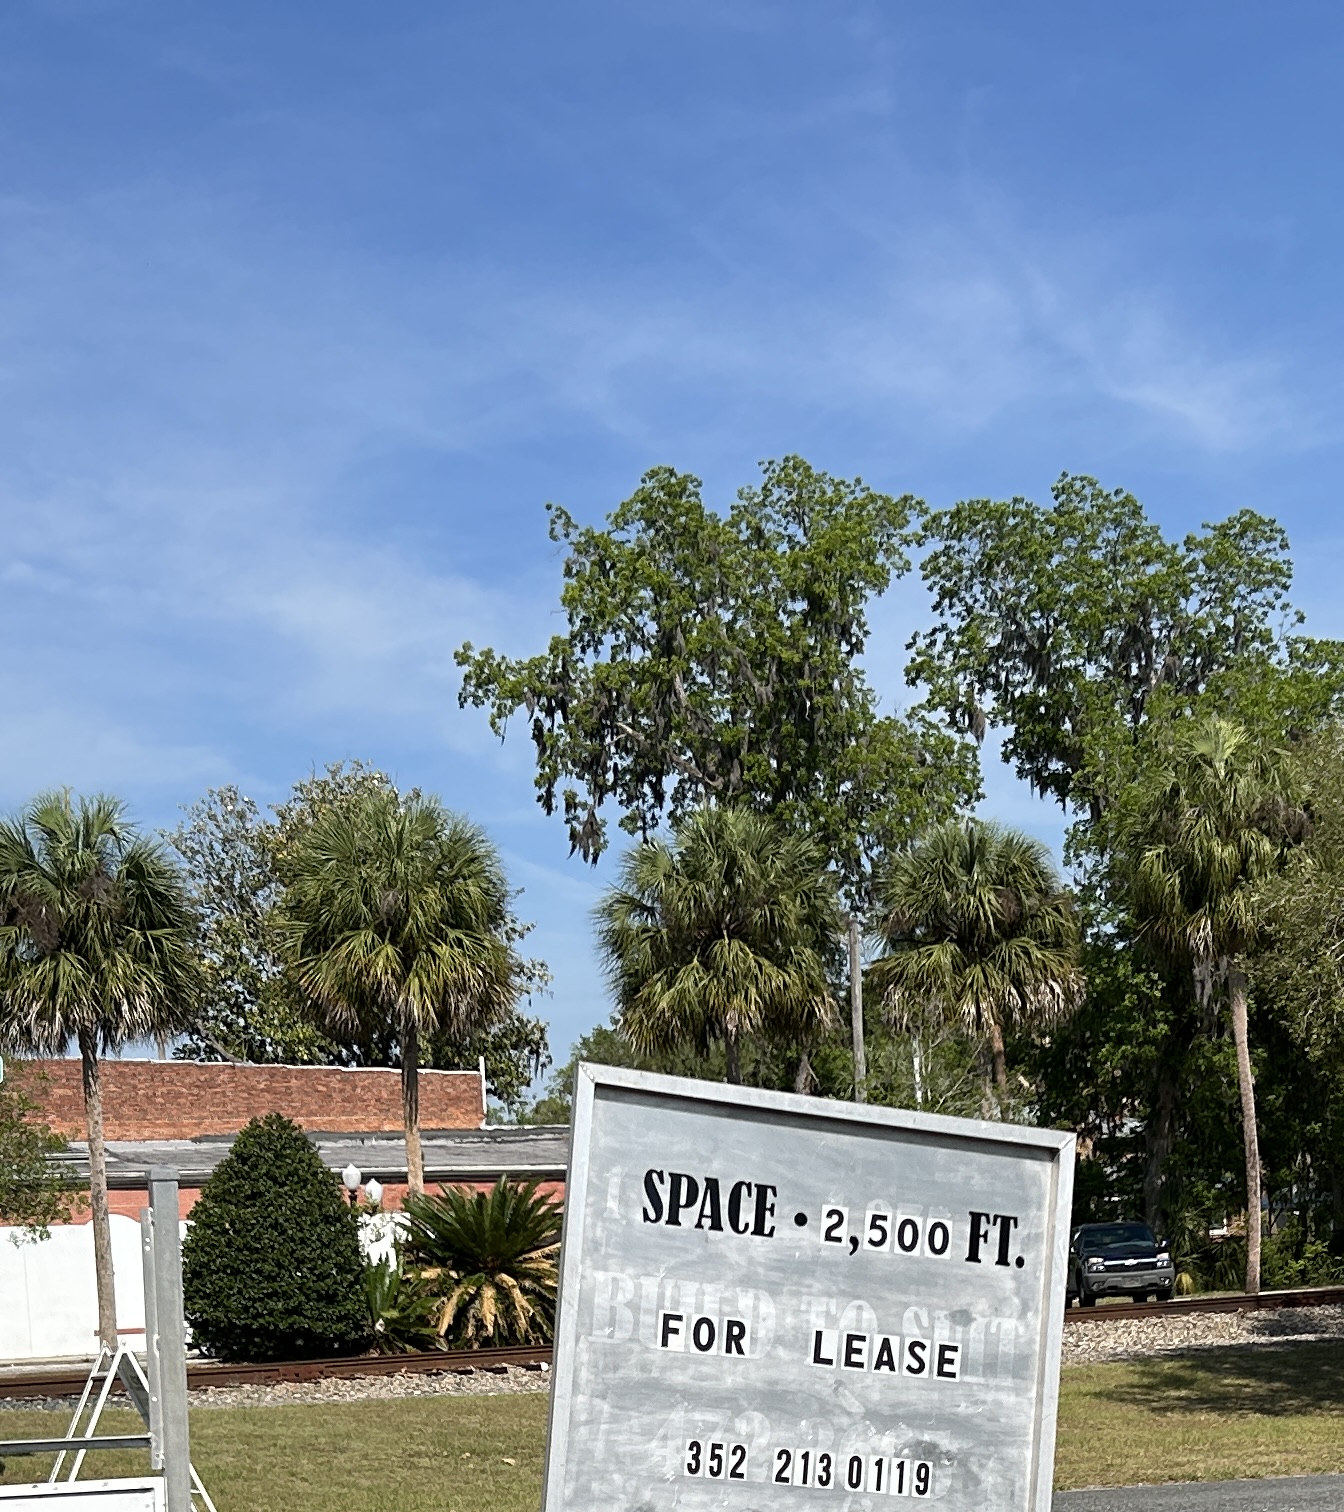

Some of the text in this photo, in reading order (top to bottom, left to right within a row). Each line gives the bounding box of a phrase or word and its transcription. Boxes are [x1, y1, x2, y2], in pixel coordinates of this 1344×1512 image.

[643, 1168, 1026, 1270] SPACE 2,500 FT.
[659, 1312, 959, 1379] FOR LEASE
[686, 1439, 747, 1480] 352
[774, 1447, 833, 1488] 213
[847, 1455, 931, 1497] 0119
